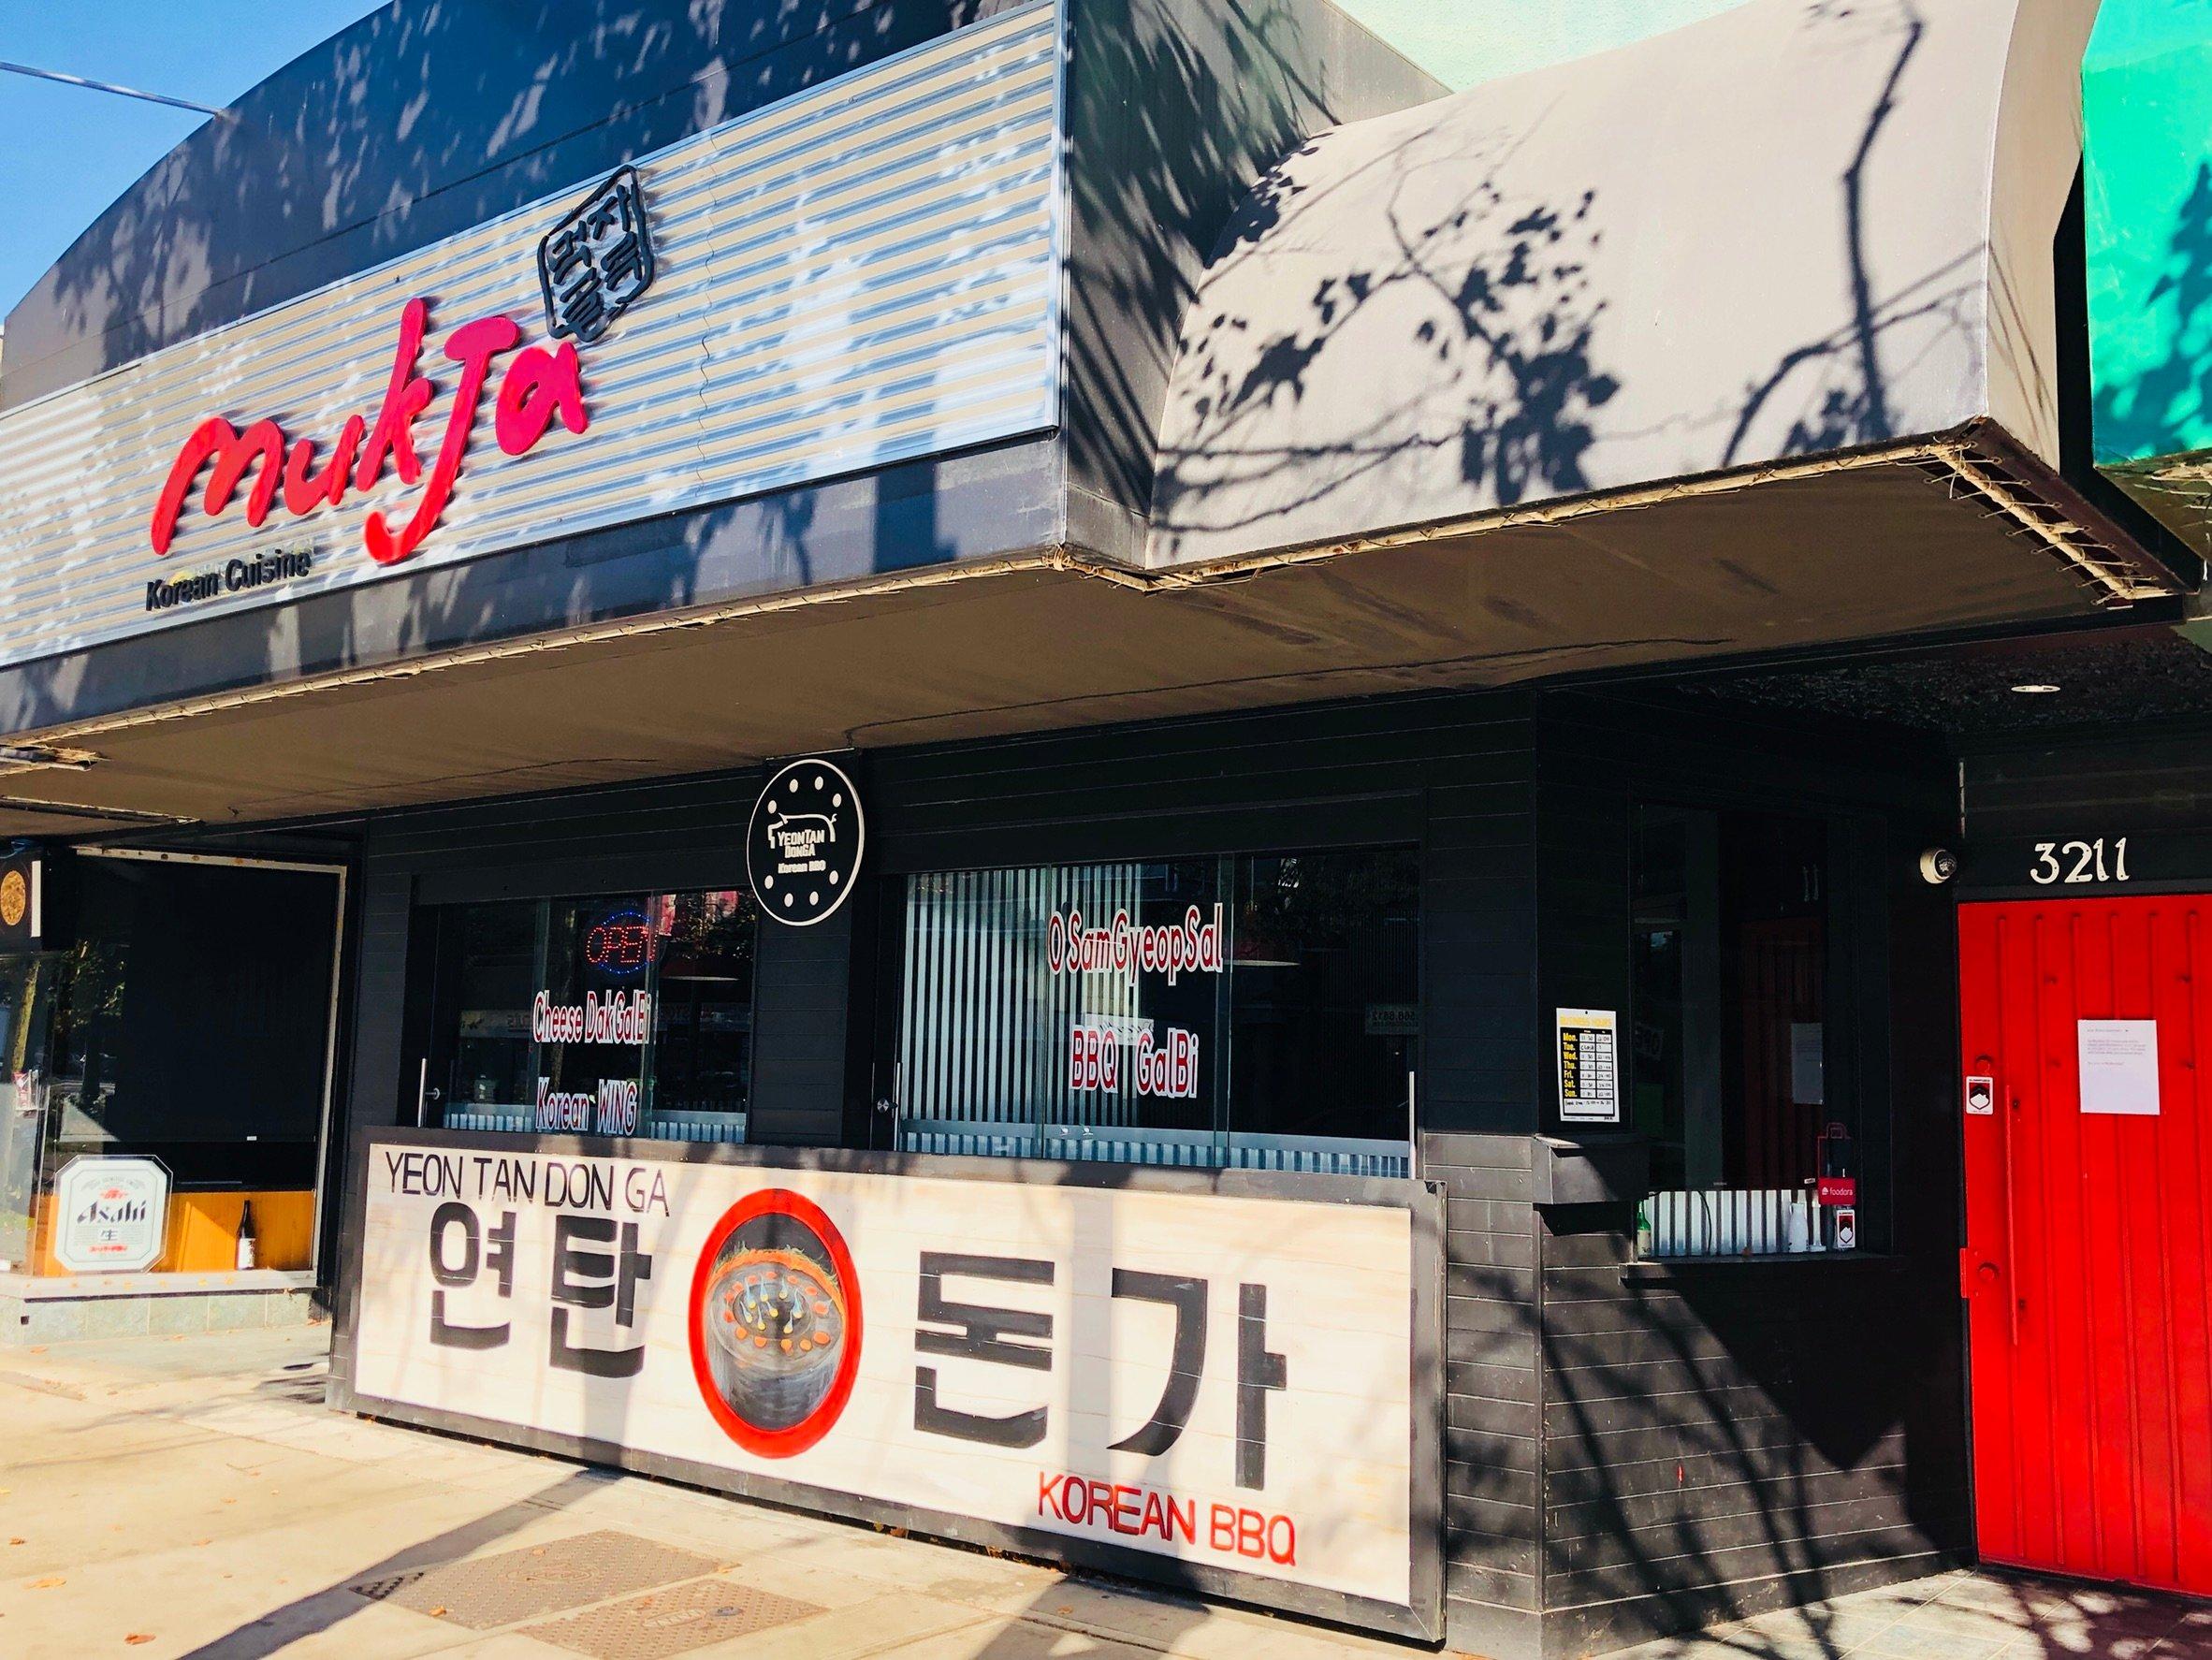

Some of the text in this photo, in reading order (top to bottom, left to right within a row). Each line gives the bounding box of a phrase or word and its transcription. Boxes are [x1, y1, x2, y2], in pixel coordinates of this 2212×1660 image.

[145, 548, 313, 611] Korean Cuisine
[2030, 837, 2131, 884] 3211
[587, 925, 659, 964] OPEN
[1067, 902, 1223, 986] SamGyeopSal
[532, 990, 583, 1042] Cheese
[1069, 1025, 1200, 1099] BBQ GalBi
[535, 1077, 638, 1136] Korean WING
[77, 1200, 147, 1224] Asahi
[386, 1151, 670, 1216] YEON TAN DON GA
[1829, 1187, 1854, 1196] foodora
[429, 1201, 1288, 1492] 연탄 돈가
[1038, 1471, 1296, 1566] KOREAN BBQ
